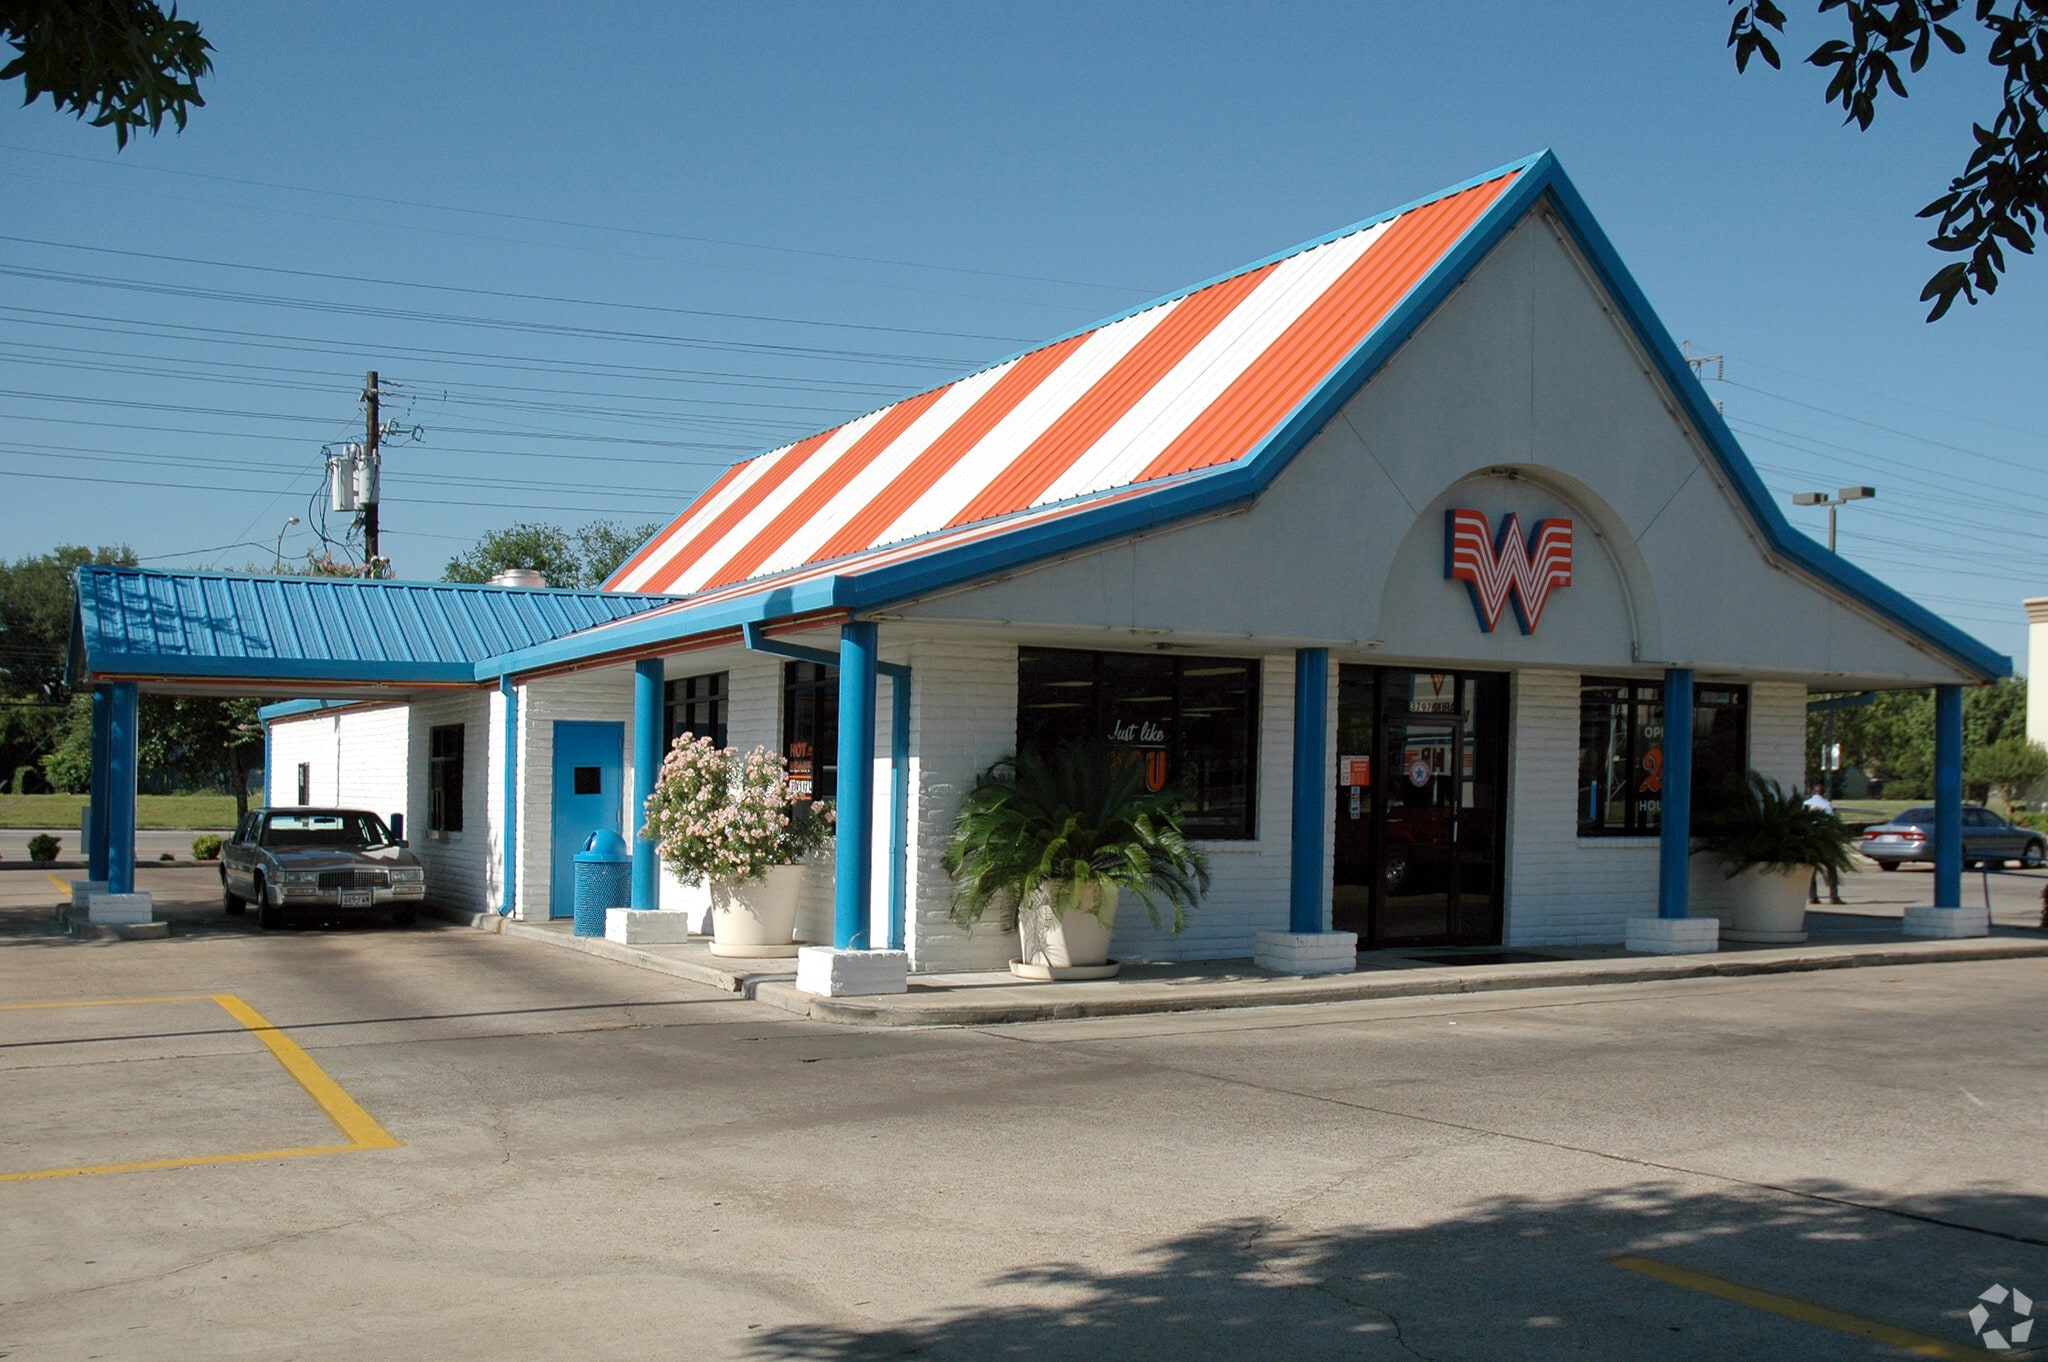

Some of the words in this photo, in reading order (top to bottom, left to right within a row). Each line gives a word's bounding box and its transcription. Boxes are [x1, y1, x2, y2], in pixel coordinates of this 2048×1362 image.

[1107, 719, 1139, 742] Just
[1140, 720, 1165, 742] like
[1644, 726, 1664, 738] OP
[1639, 747, 1663, 792] 2
